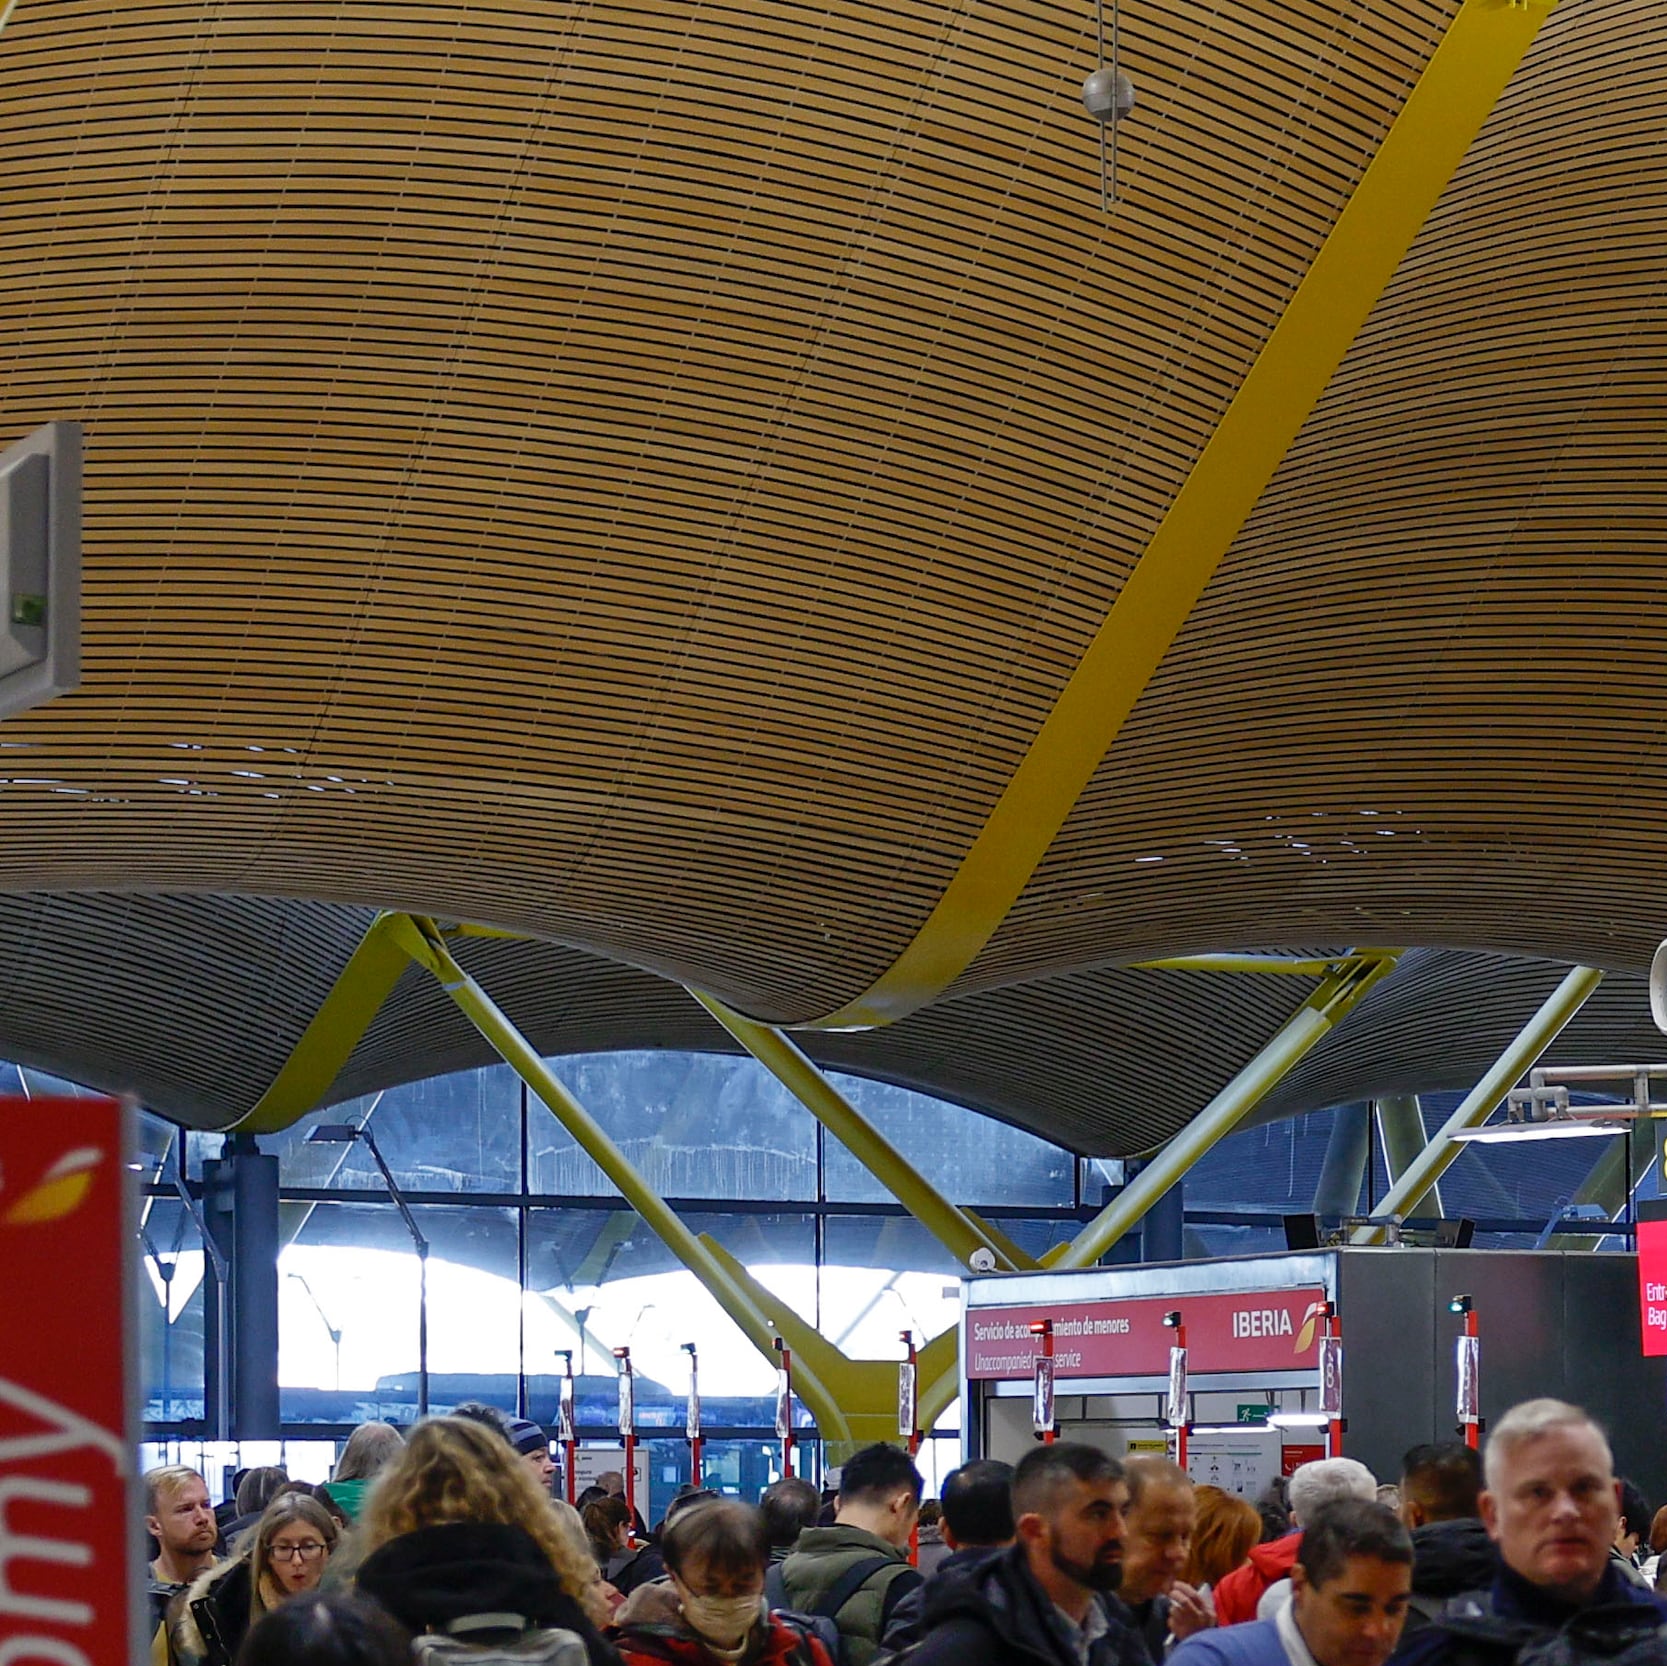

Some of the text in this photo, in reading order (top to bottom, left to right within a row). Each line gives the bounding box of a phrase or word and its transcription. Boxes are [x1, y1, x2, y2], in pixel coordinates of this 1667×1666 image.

[974, 1315, 1130, 1343] Servicio de acomiento de menores
[1232, 1308, 1293, 1339] IBERIA
[1647, 1306, 1667, 1331] Bag
[974, 1350, 1033, 1375] Unaccompanied
[1055, 1350, 1082, 1369] service
